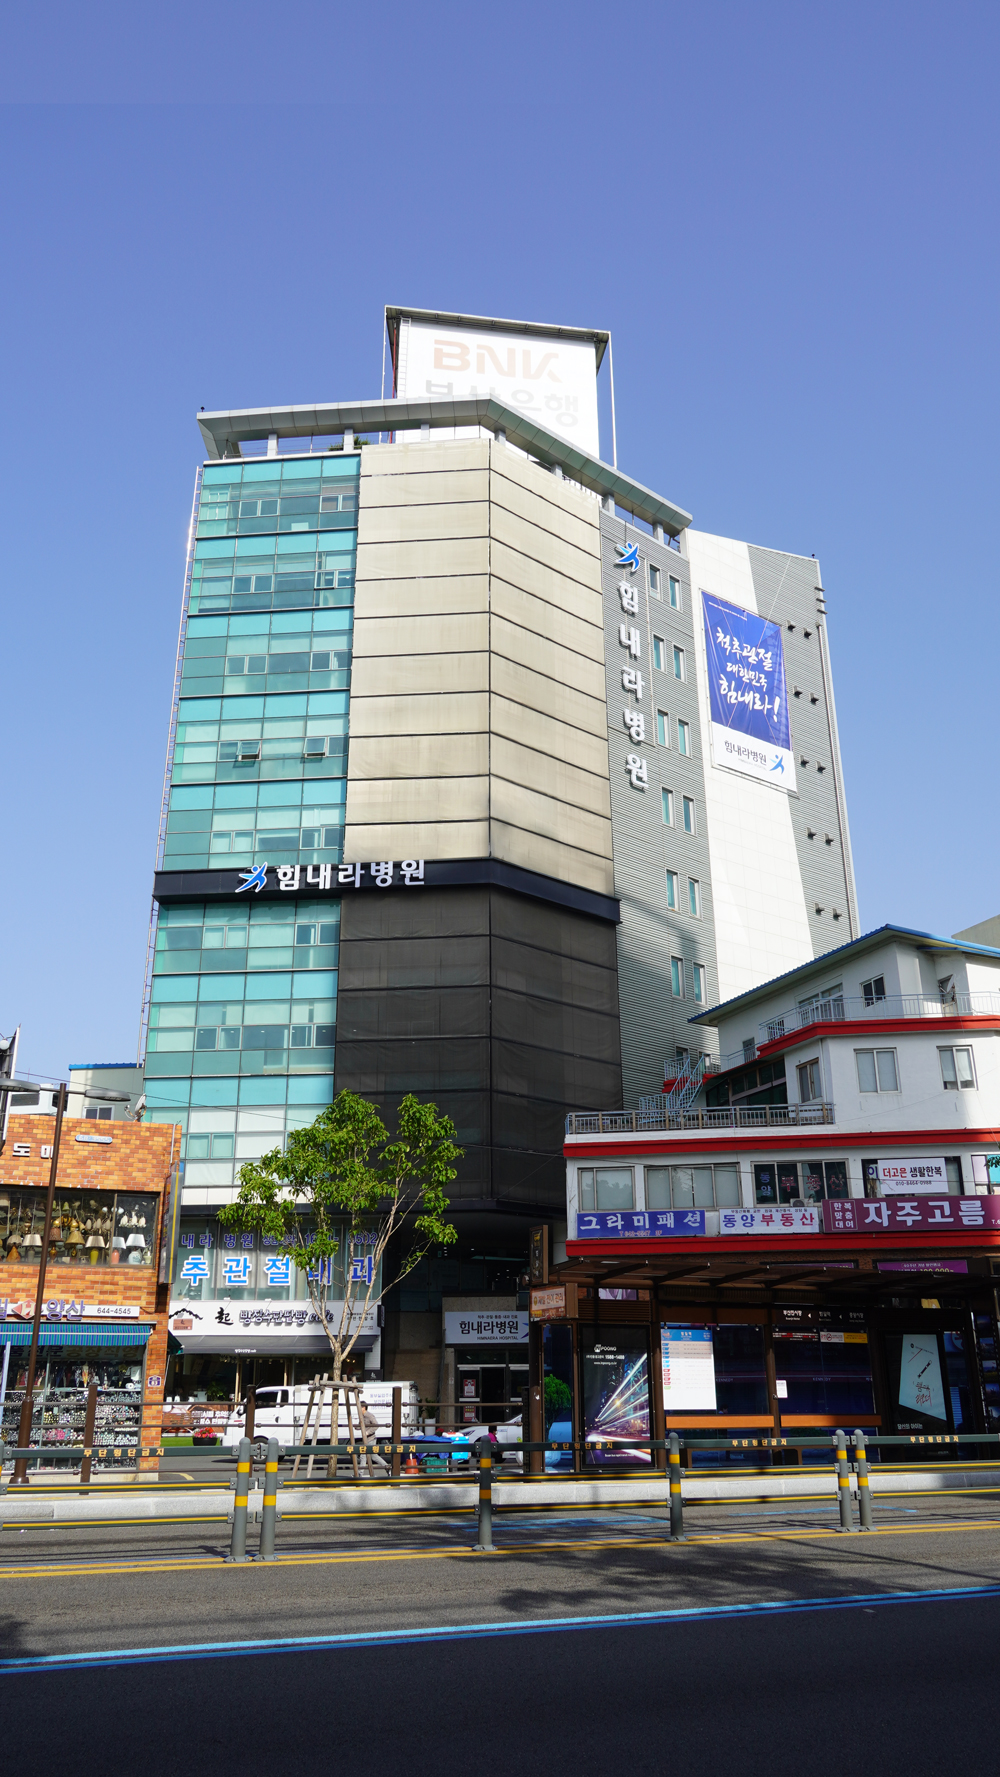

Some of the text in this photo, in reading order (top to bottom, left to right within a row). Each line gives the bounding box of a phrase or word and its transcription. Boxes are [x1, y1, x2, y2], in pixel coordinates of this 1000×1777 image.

[433, 339, 562, 383] BNK
[425, 380, 578, 428] 부은행
[716, 626, 773, 671] 척추관절
[618, 581, 649, 790] 힘내라병원
[726, 662, 767, 692] 대한민국
[719, 673, 780, 723] 힘내라!
[724, 740, 767, 766] 힘내라병원
[276, 859, 425, 890] 힘내라병원
[883, 1166, 942, 1179] 더고은 생활한복
[833, 1202, 852, 1211] 한복
[863, 1200, 985, 1227] 자주고름
[580, 1211, 701, 1230] 그라미패션
[835, 1220, 854, 1228] 대여
[46, 1299, 131, 1320] 양산 644-4545
[459, 1321, 518, 1335] 힘내라병원
